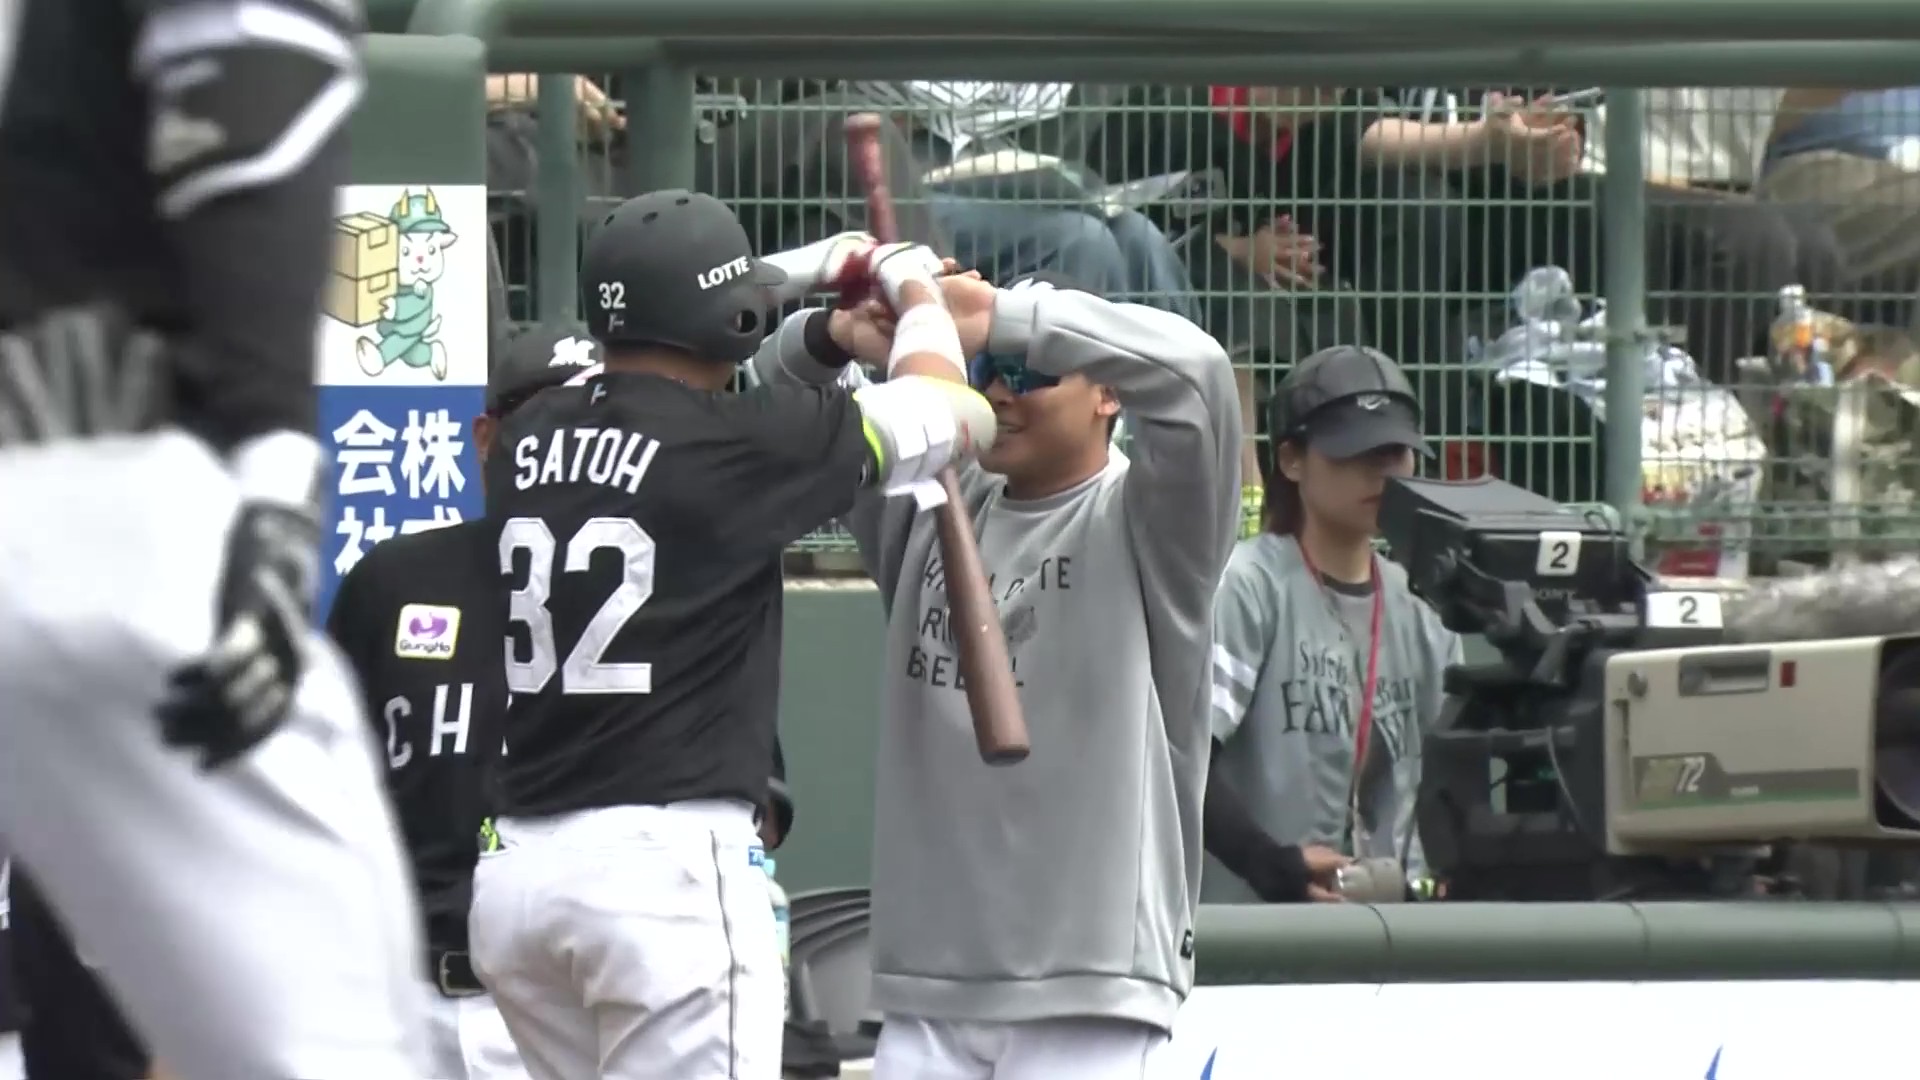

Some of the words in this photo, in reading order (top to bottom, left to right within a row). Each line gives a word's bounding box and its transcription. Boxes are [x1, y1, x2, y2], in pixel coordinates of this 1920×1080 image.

[697, 256, 750, 290] LOTTE
[599, 282, 626, 309] 32
[515, 427, 661, 494] SATOH
[1550, 541, 1570, 568] 2
[498, 517, 656, 694] 32
[1679, 596, 1698, 624] 2
